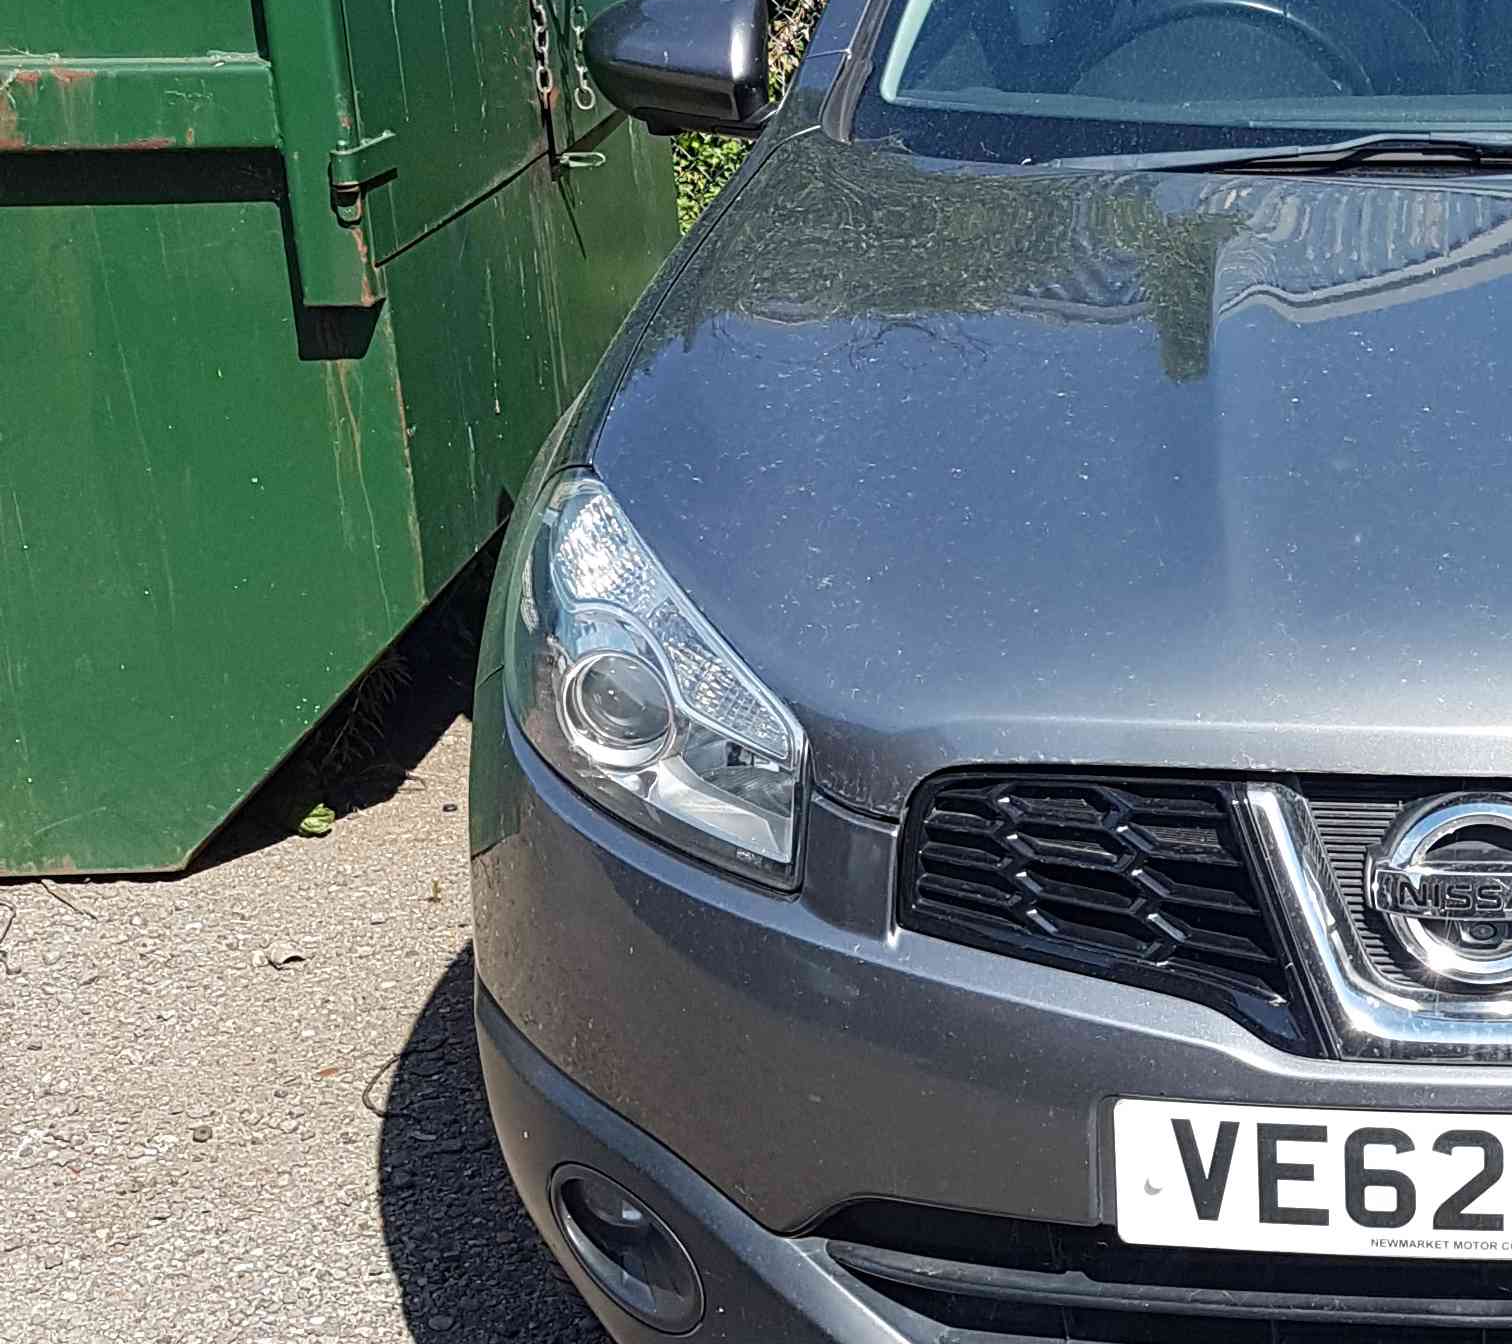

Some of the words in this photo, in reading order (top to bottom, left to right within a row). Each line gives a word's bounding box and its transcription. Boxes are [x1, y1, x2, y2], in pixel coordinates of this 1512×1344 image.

[1170, 1118, 1505, 1232] VE62
[1370, 1238, 1449, 1250] NEWMARKET
[1453, 1240, 1498, 1251] MOTOR
